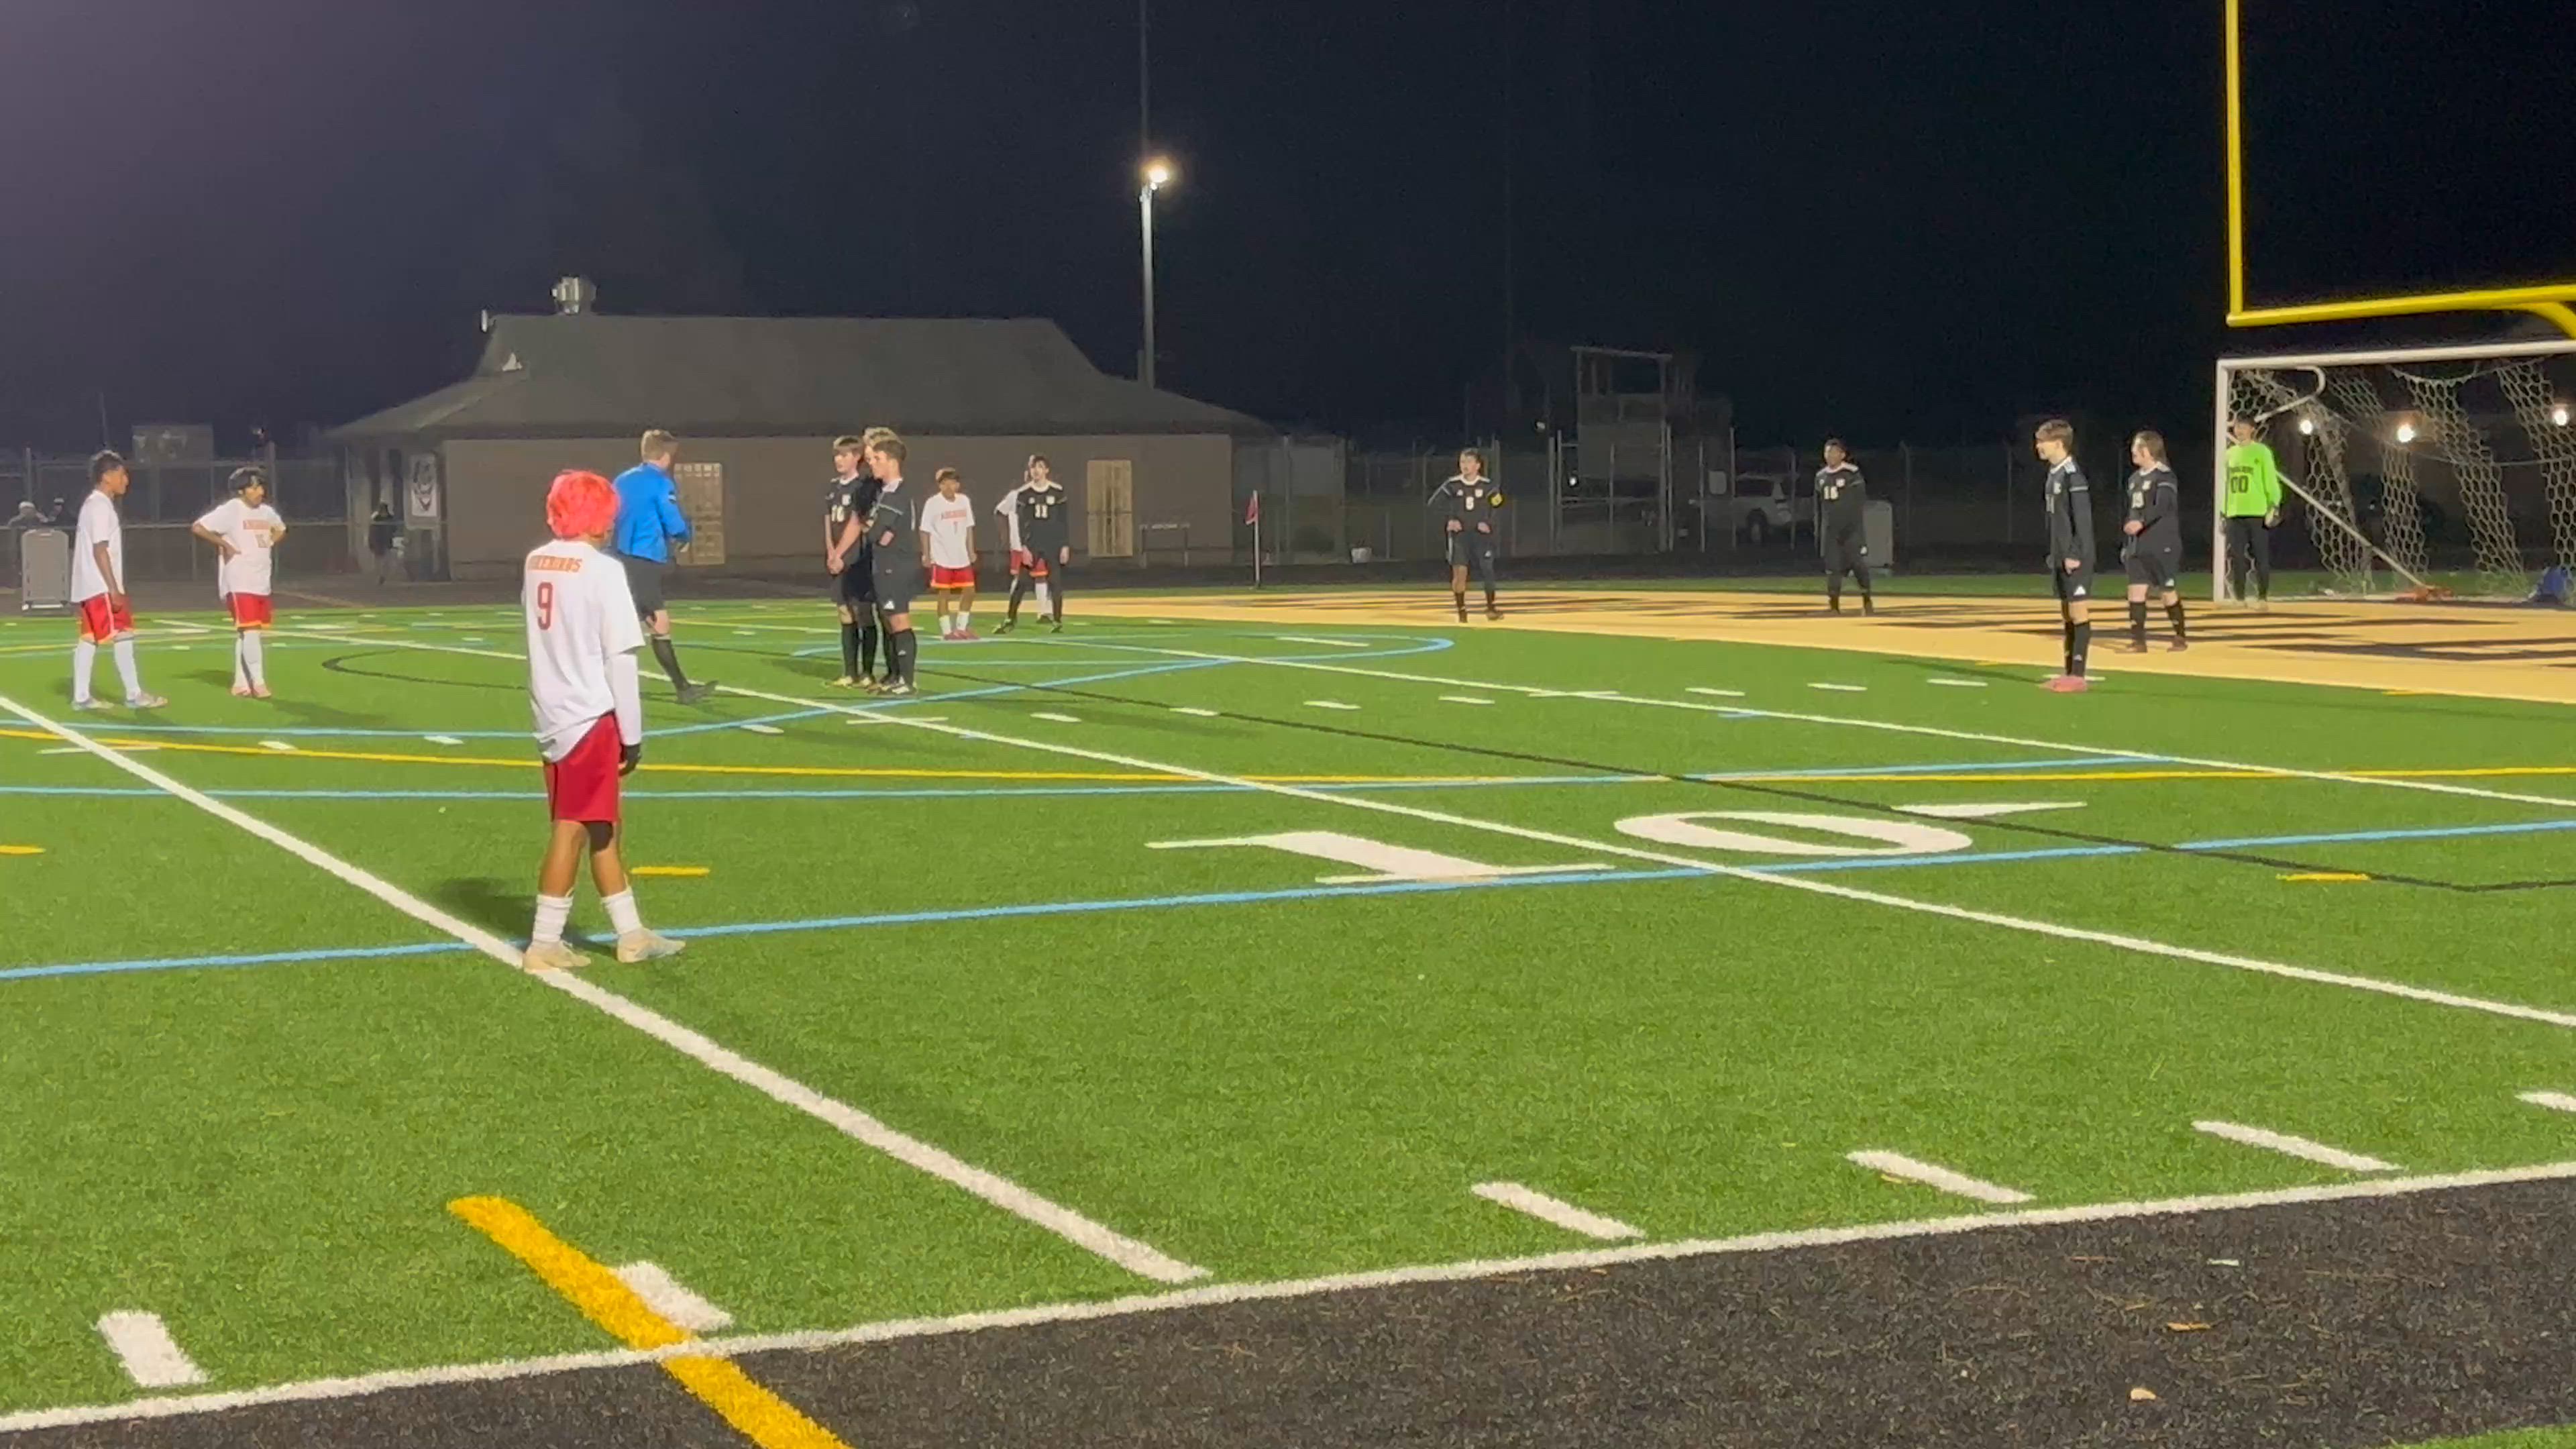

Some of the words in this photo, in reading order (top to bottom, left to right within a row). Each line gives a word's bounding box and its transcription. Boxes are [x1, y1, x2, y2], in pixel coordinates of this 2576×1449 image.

[2231, 475, 2249, 494] 00
[537, 582, 553, 630] 9
[1144, 811, 1972, 883] 10
